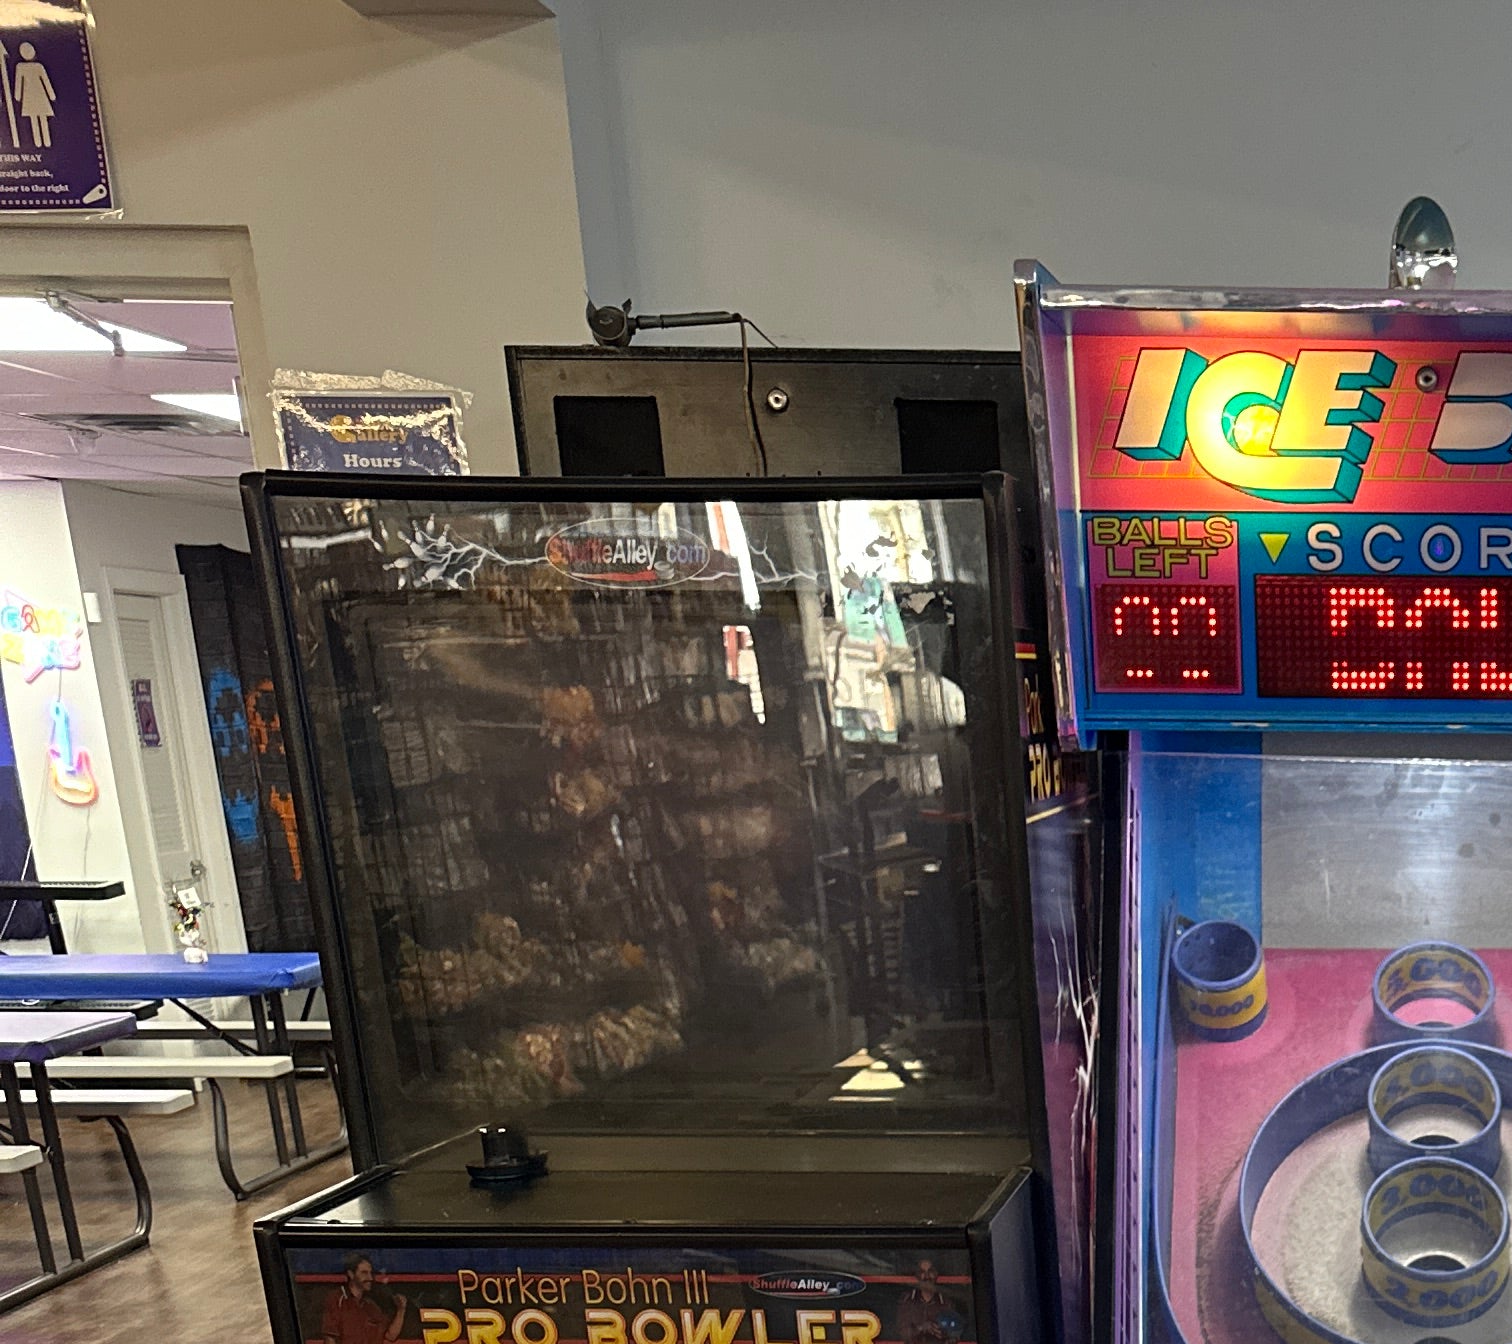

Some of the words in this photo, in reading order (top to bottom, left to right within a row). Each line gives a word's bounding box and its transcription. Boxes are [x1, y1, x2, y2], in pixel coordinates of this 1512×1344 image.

[21, 154, 42, 162] WAY
[32, 184, 46, 192] the
[47, 184, 69, 194] right
[1114, 347, 1398, 504] ICE
[344, 454, 402, 469] Hours
[1091, 516, 1234, 549] BALLS
[1106, 546, 1219, 580] LEFT
[458, 1266, 571, 1304] Parker
[581, 1267, 673, 1304] Bohn
[683, 1269, 709, 1304] III
